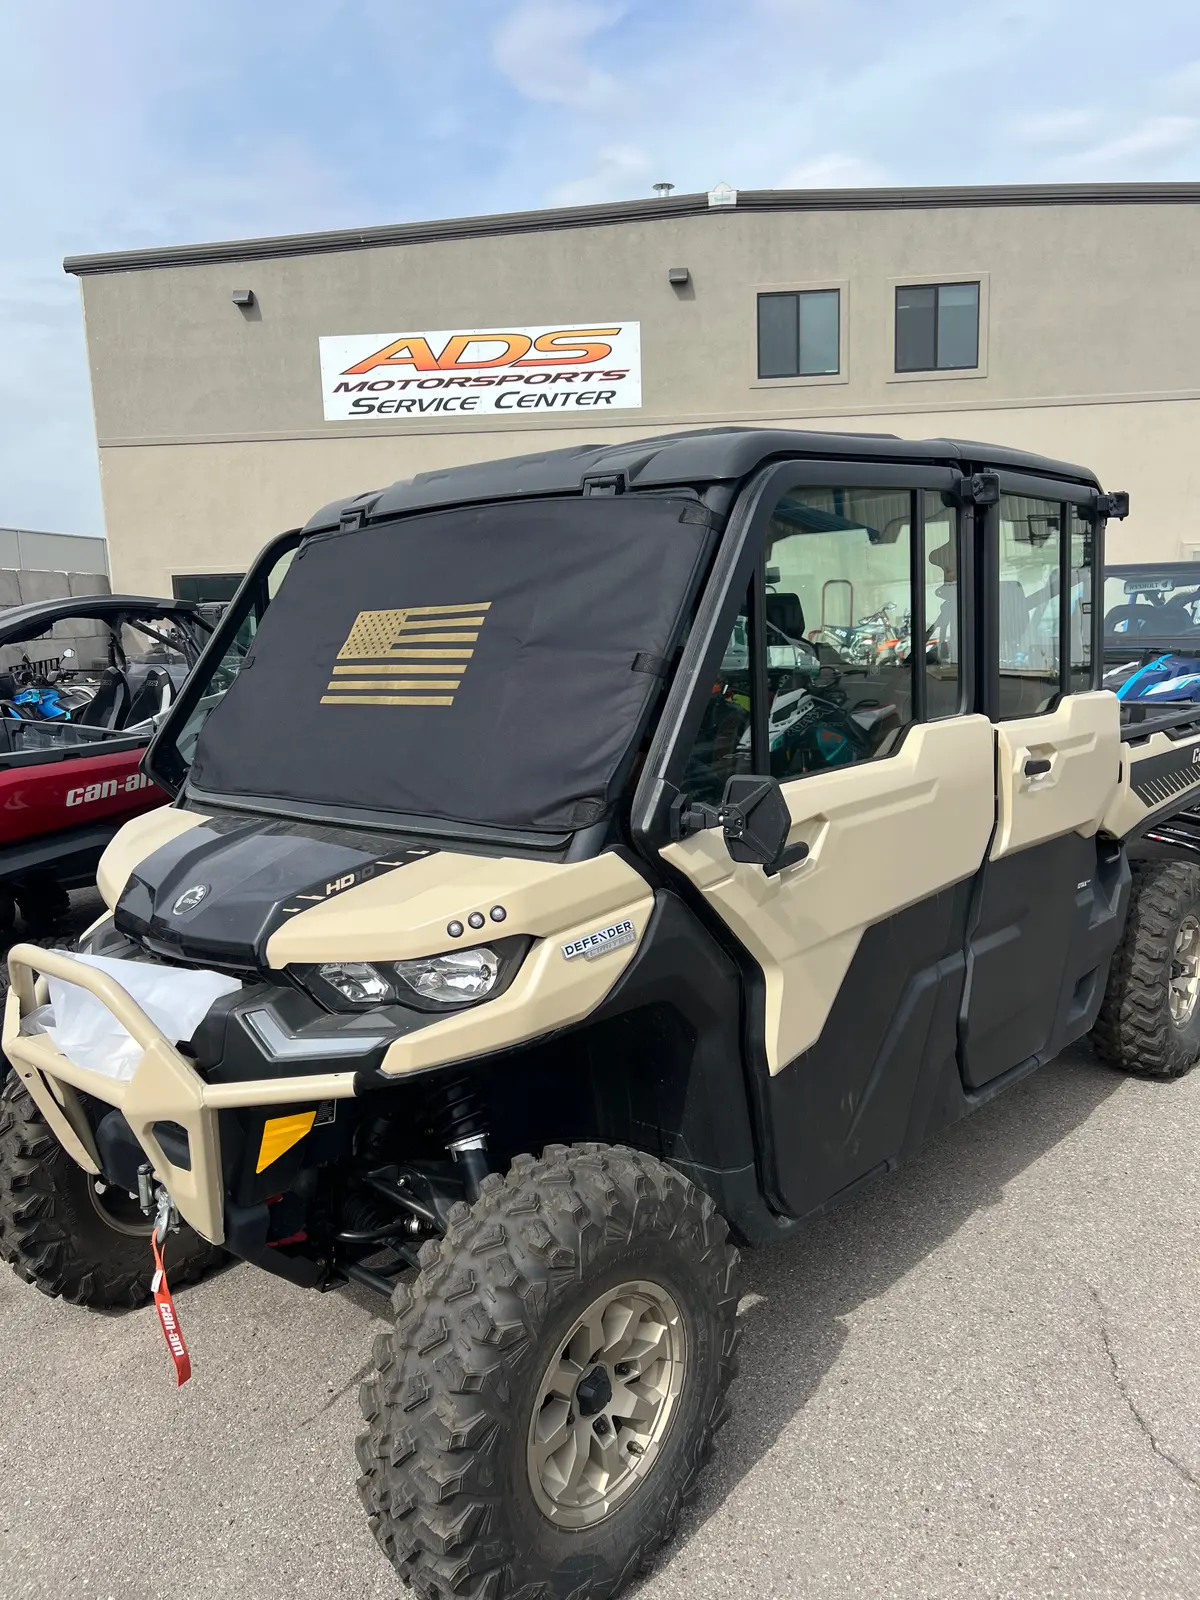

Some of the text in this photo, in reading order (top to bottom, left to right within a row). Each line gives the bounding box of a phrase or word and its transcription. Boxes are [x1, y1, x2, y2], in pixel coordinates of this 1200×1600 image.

[338, 327, 622, 375] ADS
[332, 369, 630, 394] MOTORSPORTS
[348, 390, 617, 415] SERVICE CENTER
[564, 921, 632, 956] DEFENDER
[160, 1303, 185, 1356] can-am
